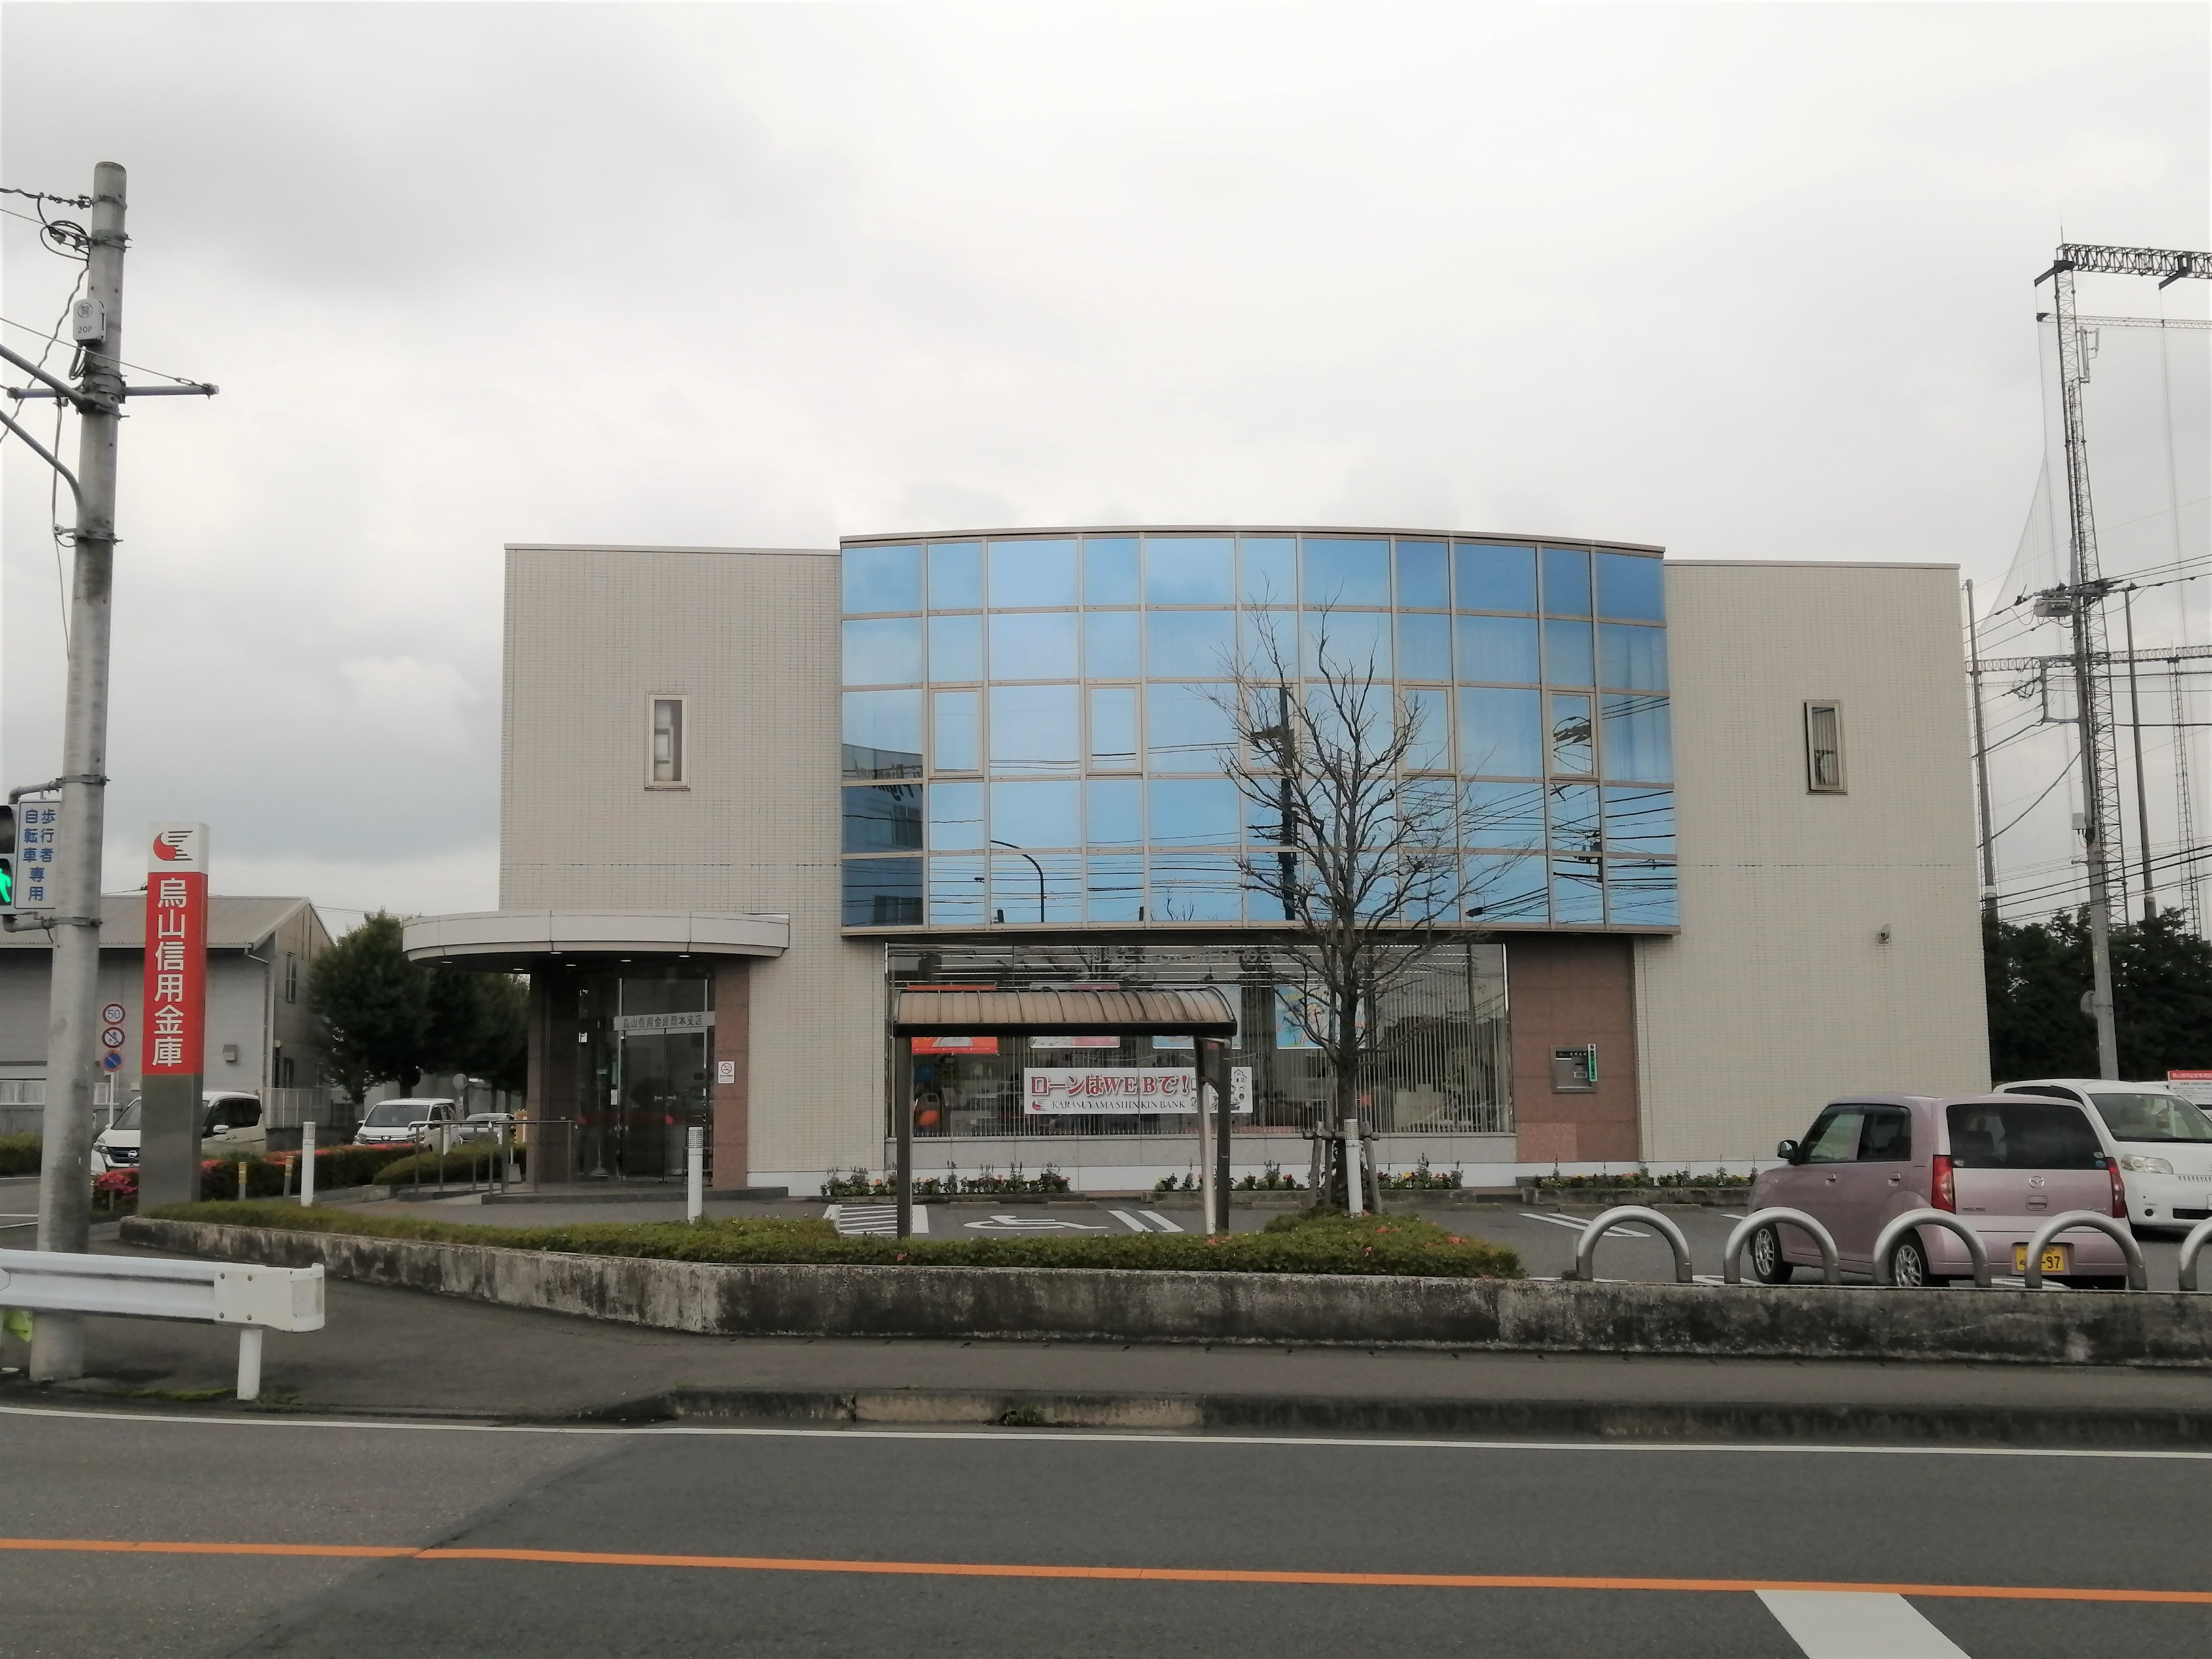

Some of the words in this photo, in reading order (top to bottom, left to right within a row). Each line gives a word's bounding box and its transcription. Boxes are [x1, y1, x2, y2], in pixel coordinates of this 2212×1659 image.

[23, 809, 38, 862] 自転車
[40, 809, 56, 862] 歩行者
[29, 866, 45, 901] 専用
[152, 877, 187, 1068] 烏山信用金庫
[107, 1009, 121, 1019] 50
[1052, 1101, 1114, 1109] KARASUYAMA
[1116, 1101, 1157, 1109] SHINKIN
[1160, 1100, 1186, 1109] BANK
